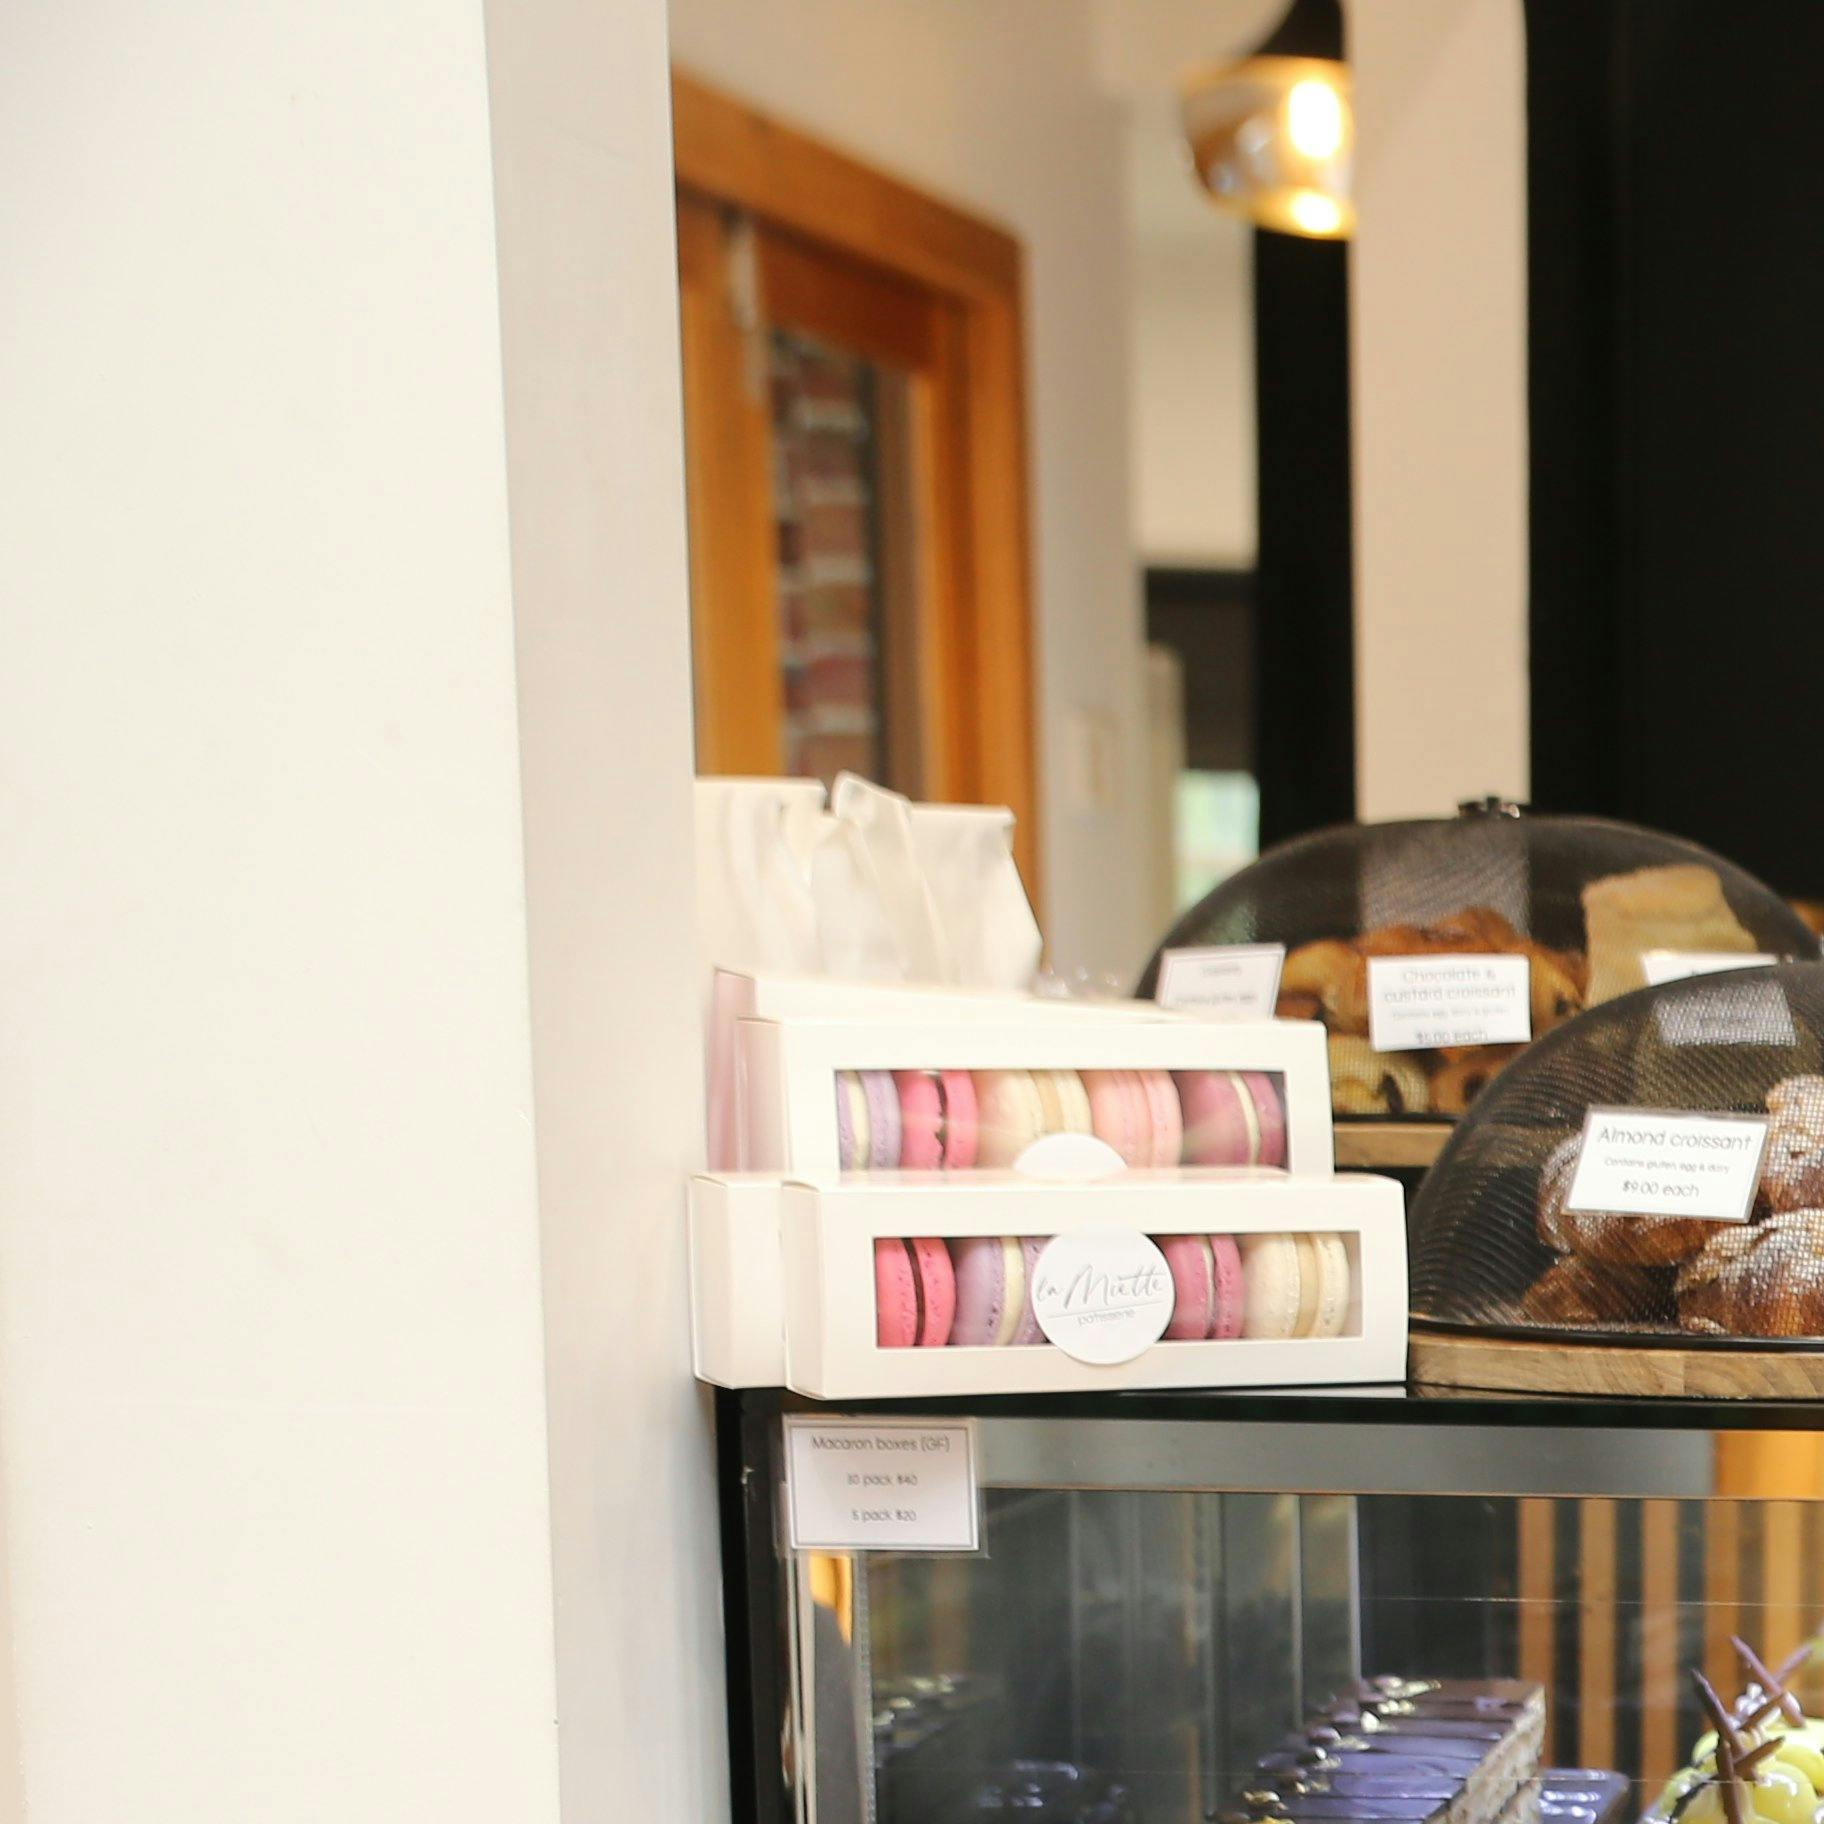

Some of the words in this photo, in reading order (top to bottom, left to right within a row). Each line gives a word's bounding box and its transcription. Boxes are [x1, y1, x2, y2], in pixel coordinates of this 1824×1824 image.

[1598, 1126, 1667, 1147] Almond
[1670, 1131, 1753, 1151] croissant
[1662, 1183, 1701, 1198] each
[811, 1434, 873, 1452] Macaron
[876, 1434, 918, 1452] boxes
[863, 1508, 891, 1525] pack
